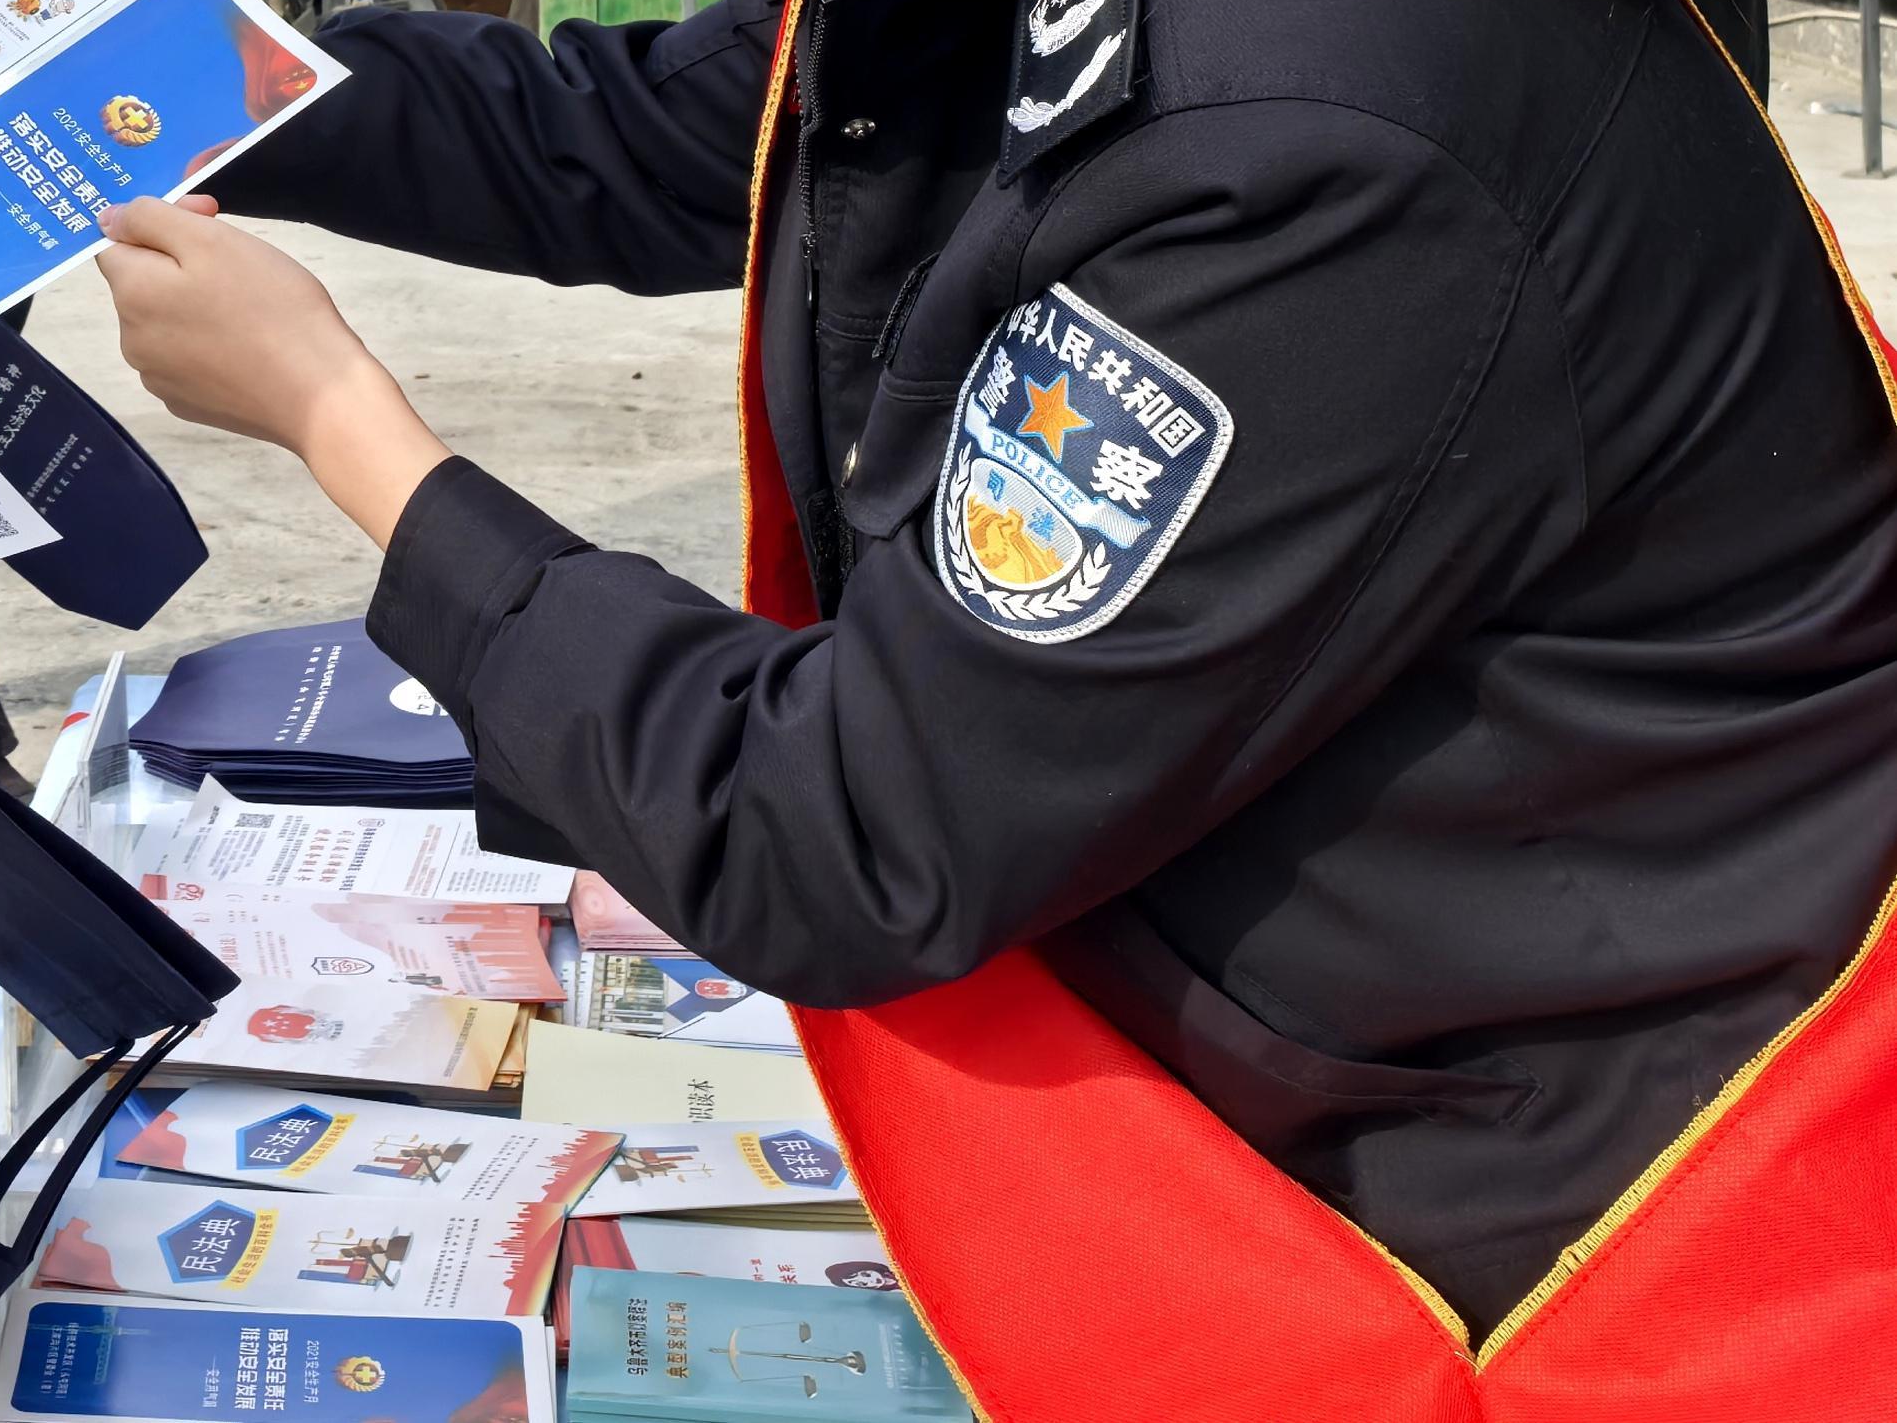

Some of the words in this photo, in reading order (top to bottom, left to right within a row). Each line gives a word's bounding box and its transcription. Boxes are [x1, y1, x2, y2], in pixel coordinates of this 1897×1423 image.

[9, 111, 112, 218] 落实安全责任
[53, 107, 133, 187] 2021安全生产月
[990, 433, 1087, 510] POLICE
[1088, 439, 1164, 510] 察
[687, 1078, 714, 1123] 识读本
[249, 1118, 318, 1163] 民法典
[771, 1140, 831, 1179] 民法典
[181, 1218, 243, 1272] 民法典
[234, 1326, 260, 1410] 推动安全发展
[263, 1327, 289, 1411] 落实安全责任
[303, 1338, 320, 1403] 2021安全生产月
[666, 1301, 689, 1378] 典型案例汇编
